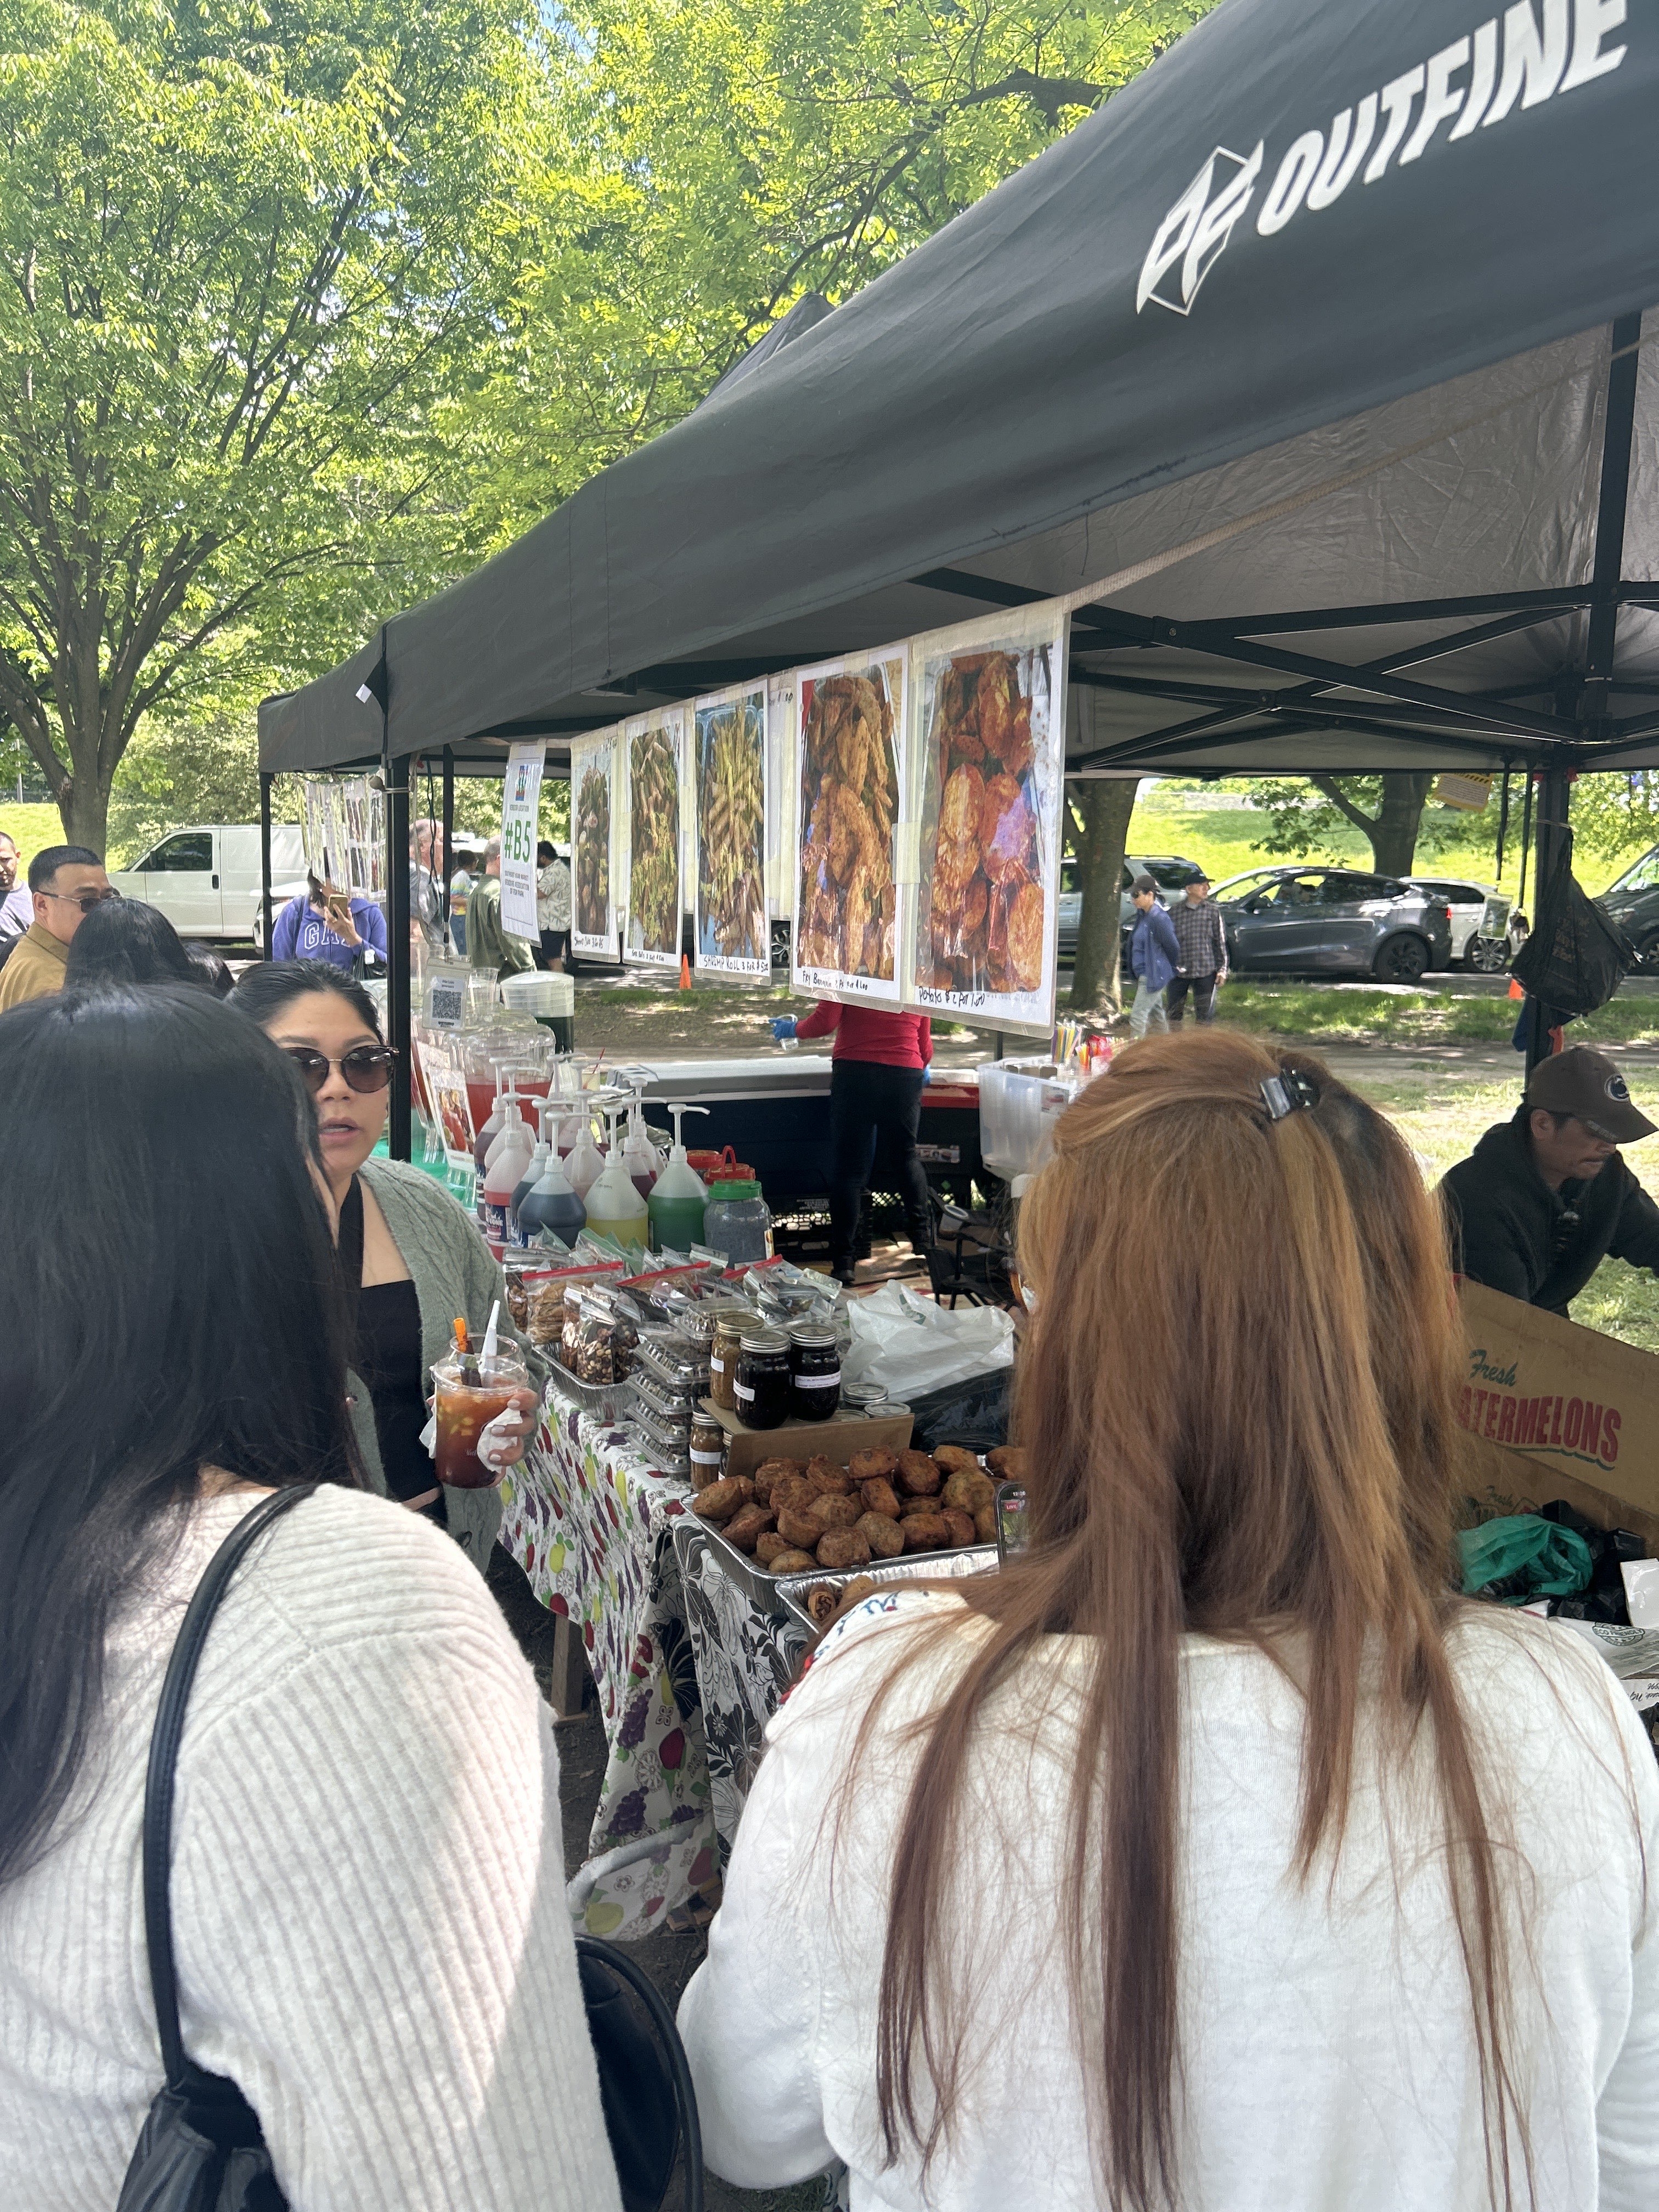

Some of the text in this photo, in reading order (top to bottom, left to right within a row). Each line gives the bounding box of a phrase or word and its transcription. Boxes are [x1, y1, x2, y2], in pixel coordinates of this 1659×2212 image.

[1255, 0, 1628, 236] OUTFINE
[504, 820, 531, 863] #B5
[304, 922, 351, 950] GA
[742, 961, 745, 970] 3
[1469, 1348, 1518, 1387] Fresh
[1455, 1384, 1622, 1463] ATERMELONS
